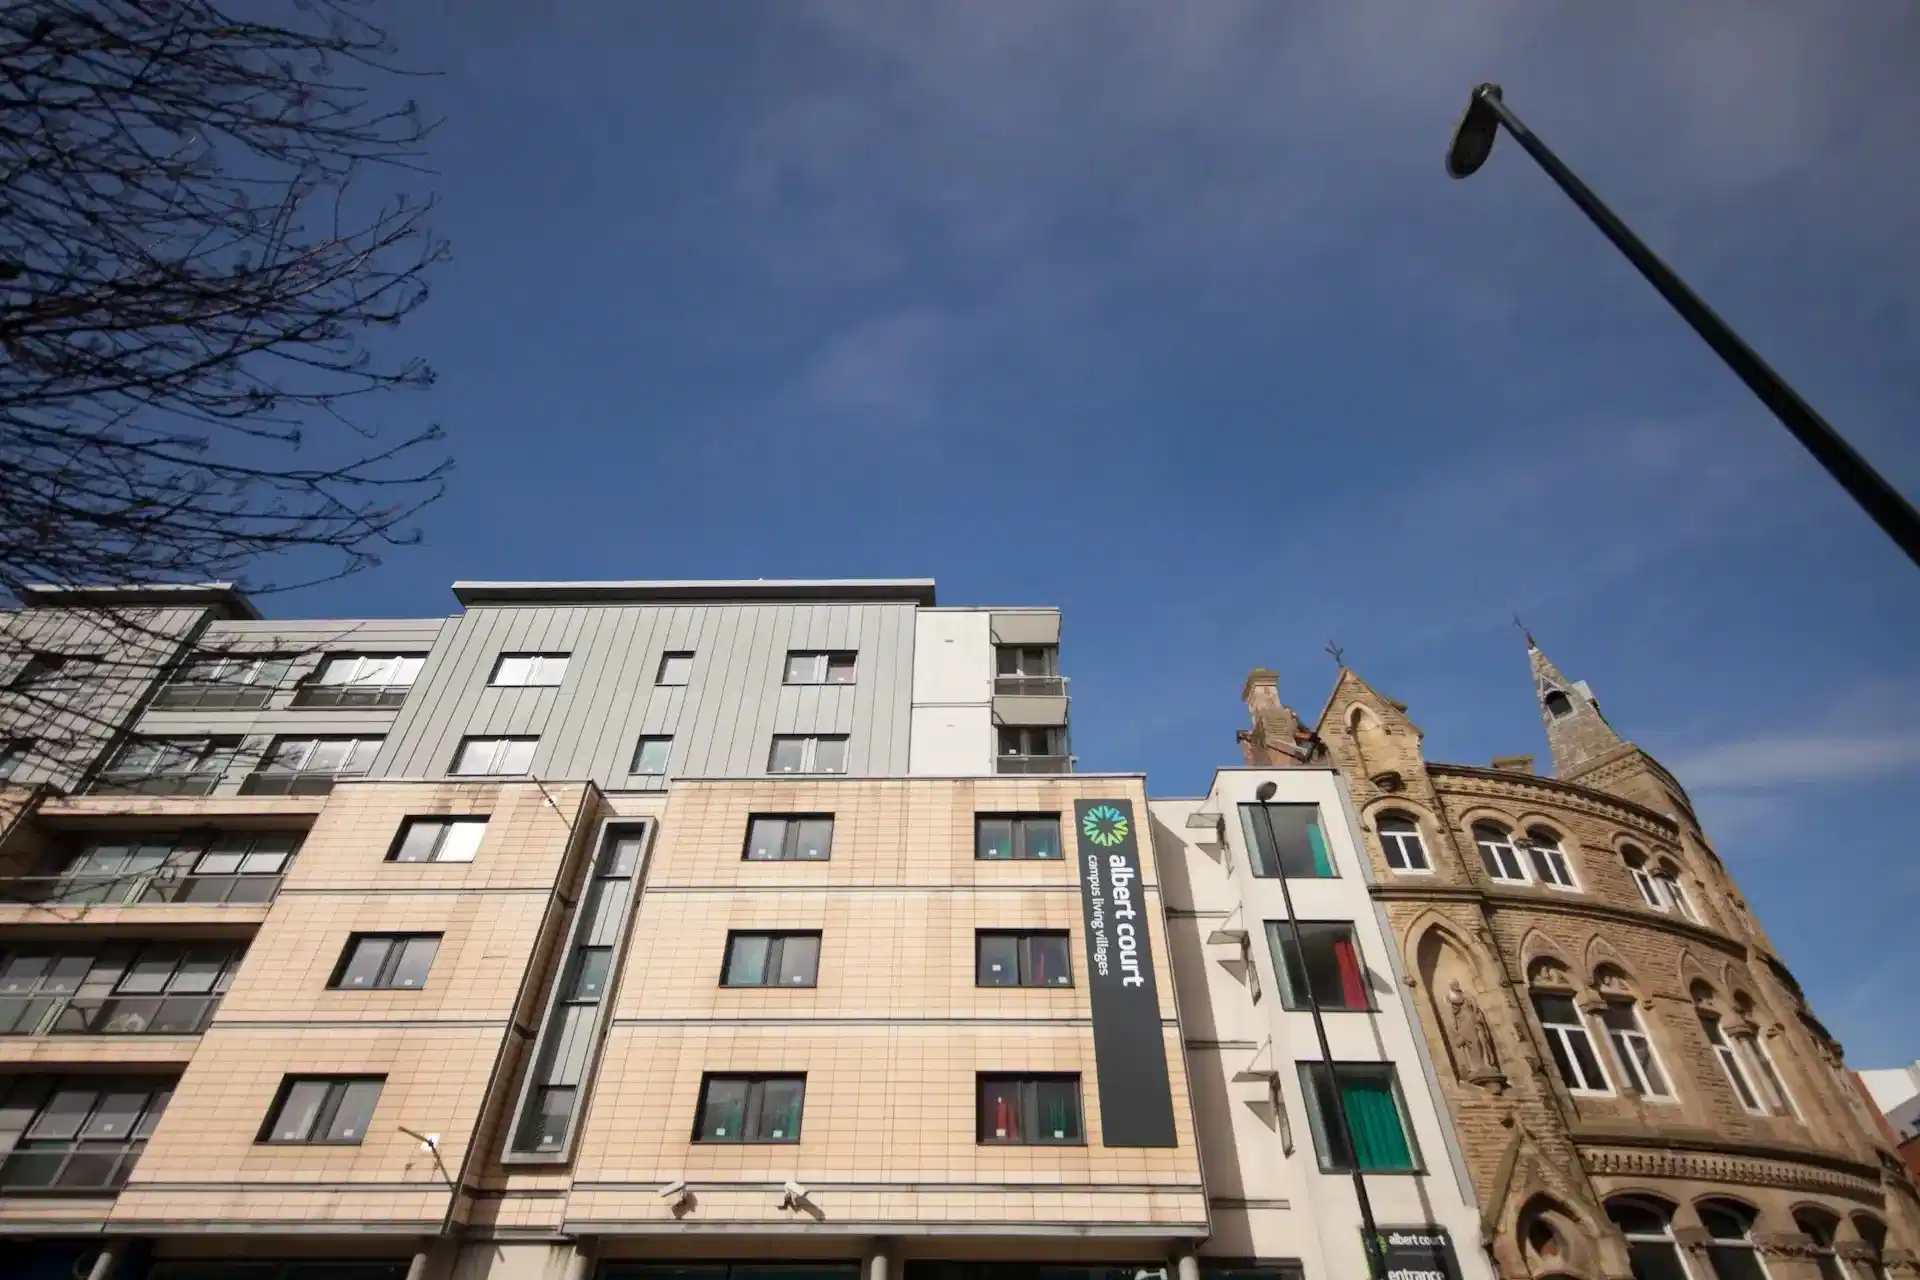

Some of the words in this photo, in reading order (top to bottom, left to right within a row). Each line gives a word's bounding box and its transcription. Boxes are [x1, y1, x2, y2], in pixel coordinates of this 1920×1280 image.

[1087, 855, 1100, 896] campus
[1109, 855, 1136, 919] albert
[1090, 898, 1104, 929] living
[1093, 930, 1109, 976] villages
[1116, 923, 1144, 987] court
[1388, 1232, 1418, 1246] albert
[1387, 1268, 1445, 1280] entrance
